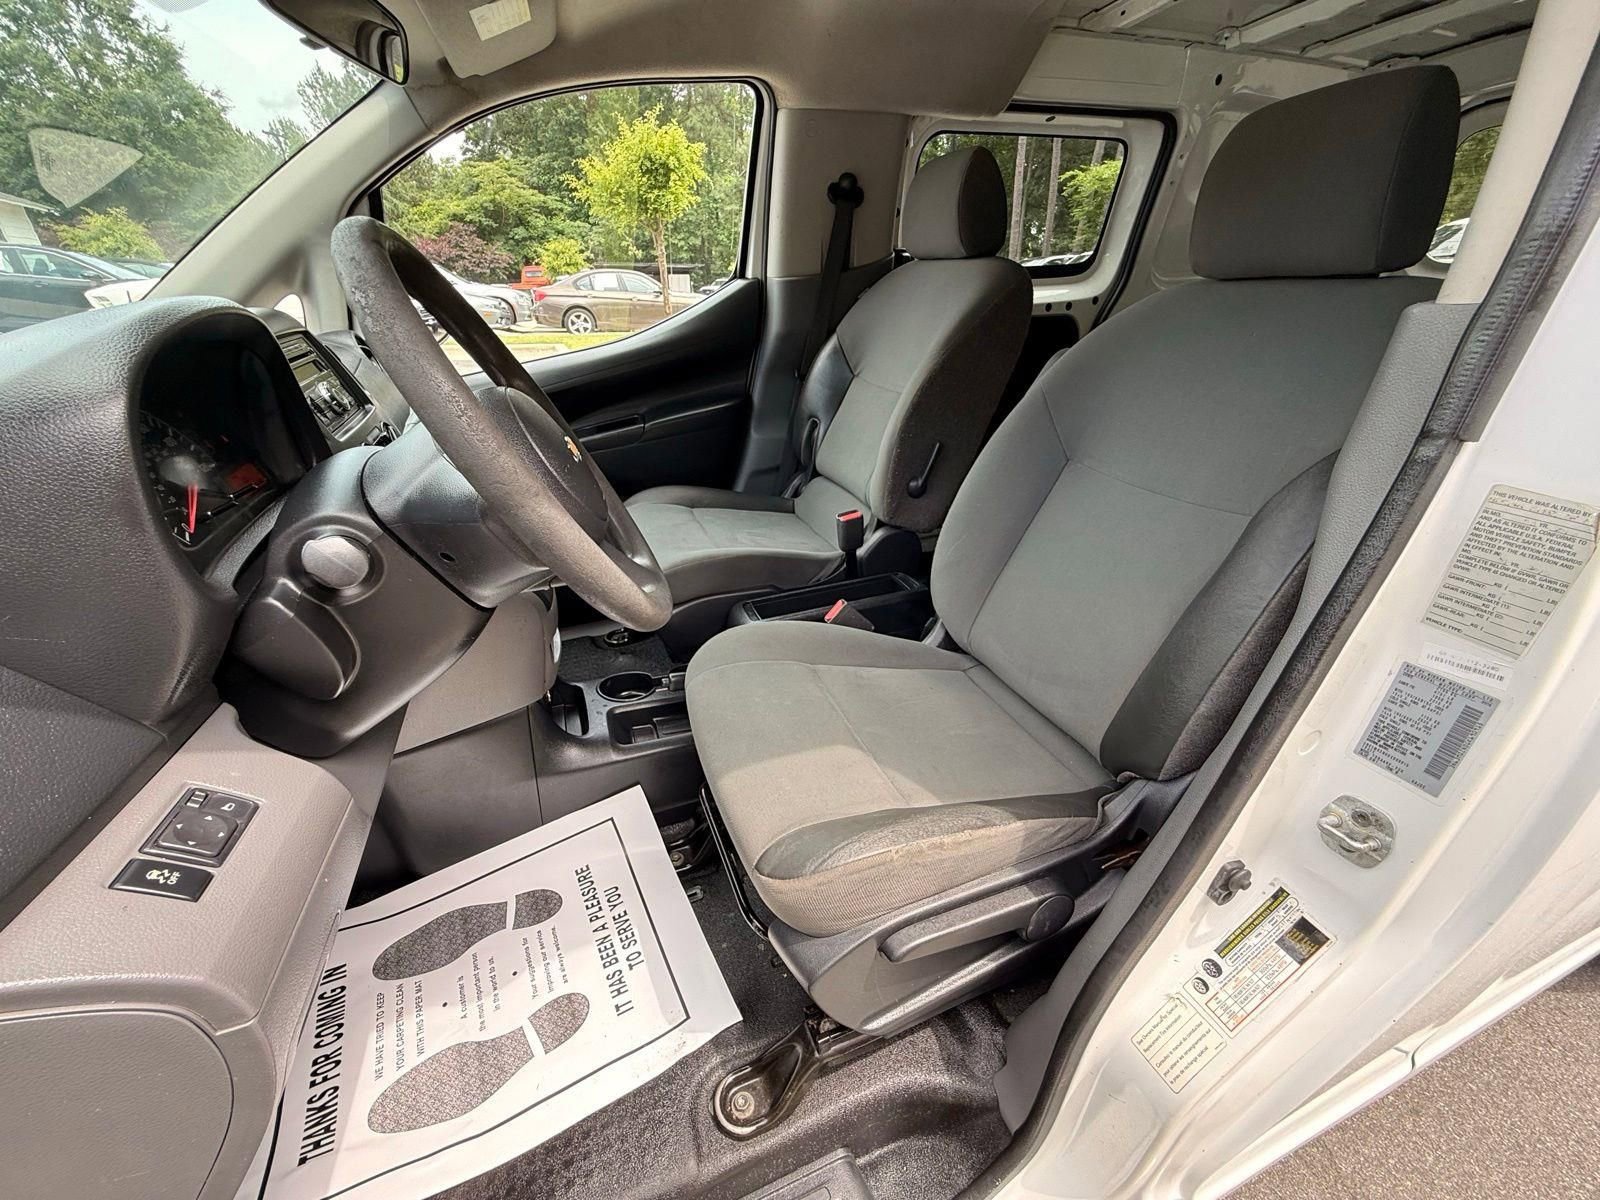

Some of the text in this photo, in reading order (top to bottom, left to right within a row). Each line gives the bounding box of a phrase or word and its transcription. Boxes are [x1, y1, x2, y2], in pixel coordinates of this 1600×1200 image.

[1507, 493, 1533, 504] VEHICLE
[1533, 499, 1551, 508] WAS
[1549, 503, 1581, 515] ALTERED
[1478, 513, 1492, 521] AND
[1501, 519, 1531, 531] ALTERED
[1538, 528, 1577, 544] CONFORMS
[1487, 522, 1523, 537] APPLICABLE
[1544, 537, 1575, 550] FEDERAL
[1466, 536, 1496, 549] AFFECTED
[1506, 547, 1519, 555] THE
[1518, 550, 1559, 566] ALTERATION
[1558, 561, 1575, 570] AND
[1469, 531, 1483, 539] AND
[1483, 534, 1502, 544] THEFT
[1502, 539, 1542, 555] PREVENTION
[1470, 544, 1492, 554] EFFECT
[1472, 525, 1495, 535] MOTOR
[1494, 531, 1520, 542] VEHICLE
[1547, 544, 1577, 557] BUMPER
[1457, 552, 1489, 566] COMPLETE
[1488, 561, 1511, 572] BELOW
[167, 871, 181, 885] OFF
[536, 929, 545, 950] service
[575, 864, 634, 1016] IT HAS BEEN A PLEASURE
[604, 886, 644, 971] TO SERVE YOU
[472, 952, 480, 972] person
[524, 946, 536, 982] suggestions
[557, 953, 565, 972] always
[489, 974, 498, 994] world
[531, 984, 539, 999] Your
[415, 994, 423, 1018] PAPER
[459, 983, 468, 1012] customer
[476, 1003, 485, 1019] most
[375, 993, 387, 1081] WE HAVE TRIED TO KEEP
[394, 983, 408, 1071] YOUR CARPETING CLEAN
[416, 1019, 424, 1036] THIS
[417, 1037, 425, 1057] WITH
[297, 964, 347, 1167] THANKS FOR COMING IN
